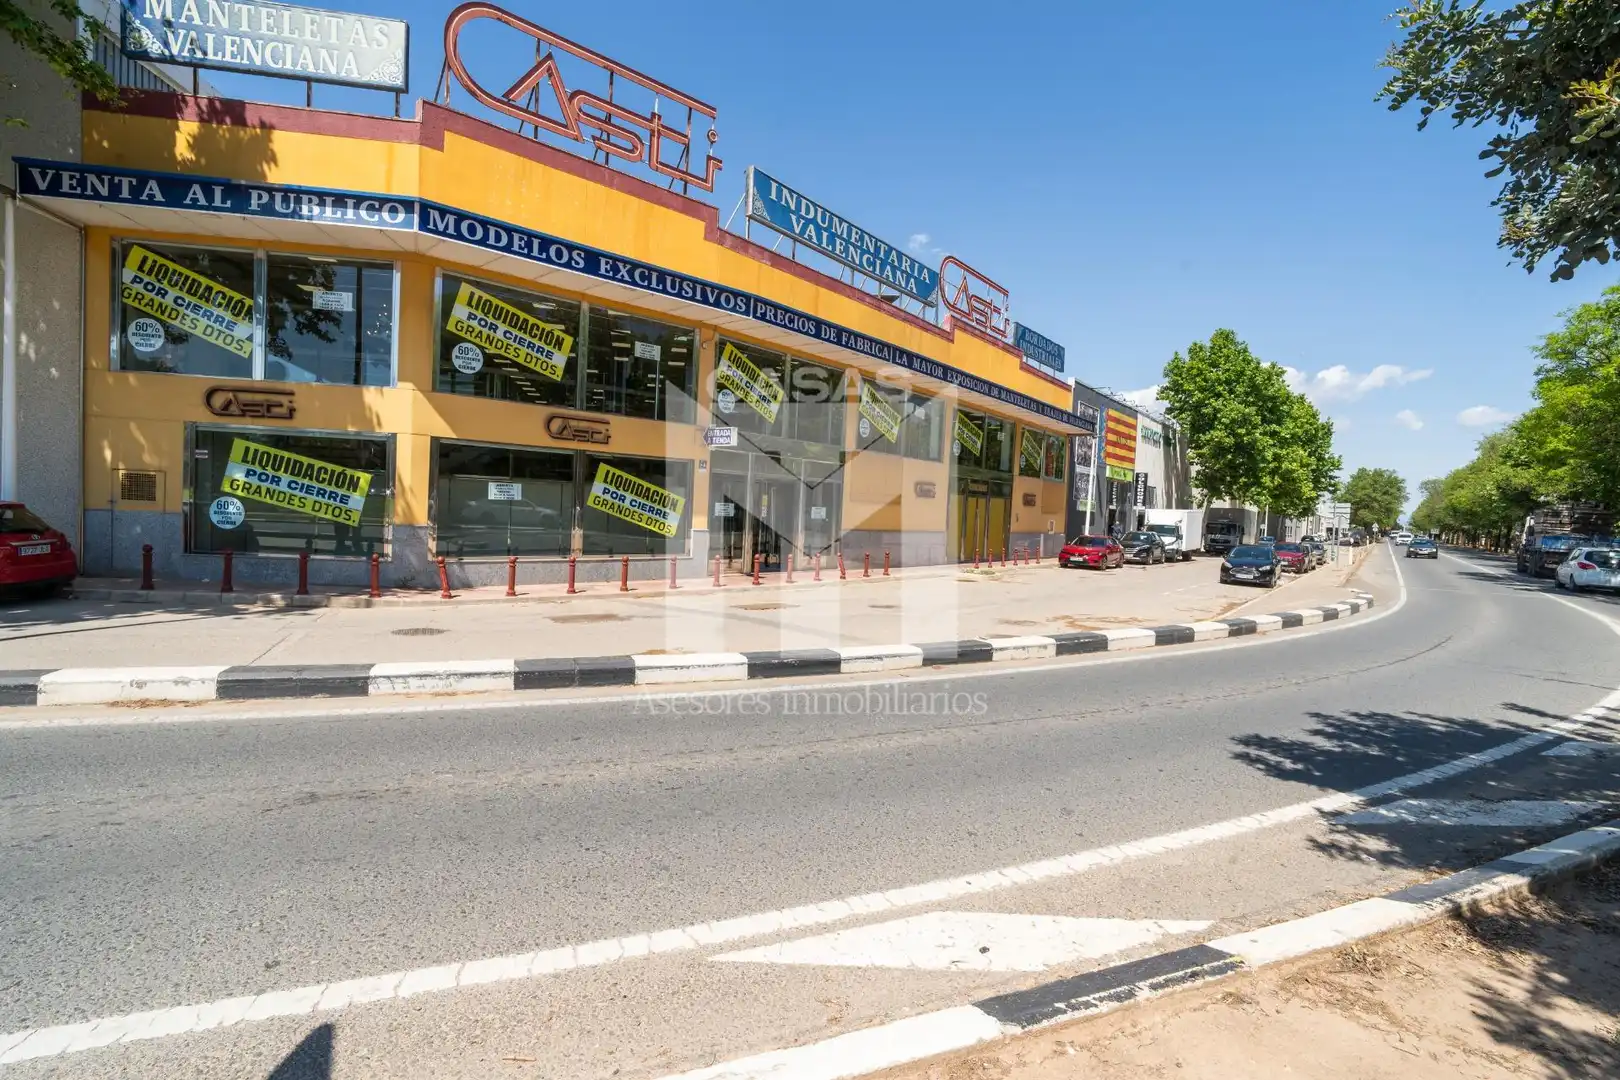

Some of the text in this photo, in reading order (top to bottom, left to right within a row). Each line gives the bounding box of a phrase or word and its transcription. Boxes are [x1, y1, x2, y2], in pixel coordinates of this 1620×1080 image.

[143, 0, 389, 50] MANTELETAS
[163, 27, 361, 78] VALENCIANA
[28, 167, 407, 225] VENTA AL PUBLICO
[768, 180, 931, 284] INDUMENTARIA
[789, 213, 918, 294] VALENCIANA
[426, 207, 748, 312] MODELOS EXCLUSIVOS
[121, 286, 248, 354] GRANDES DTOS.
[130, 274, 239, 332] POR CIERRE
[134, 321, 160, 334] 60%
[465, 290, 565, 352] LIQUIDACIÓN
[454, 320, 560, 378] GRANDES DTOS.
[457, 345, 480, 357] 60%
[465, 311, 555, 361] POR CIERRE
[755, 302, 890, 360] PRECIOS DE FABRICA
[1025, 329, 1059, 356] BORDADOS
[895, 350, 908, 366] LA
[912, 357, 944, 379] MAYOR
[947, 369, 989, 394] EXPOSICION
[990, 384, 1000, 398] DE
[999, 388, 1038, 412] MANTELETAS
[240, 445, 361, 493] LIQUIDACIÓN
[244, 468, 351, 506] POR CIERRE
[602, 469, 679, 513] LIQUIDACIÓN
[216, 500, 241, 511] 60%
[229, 478, 356, 523] GRANDES DTOS.
[592, 496, 674, 536] GRANDES DTOS.
[601, 486, 671, 521] POR CIERRE
